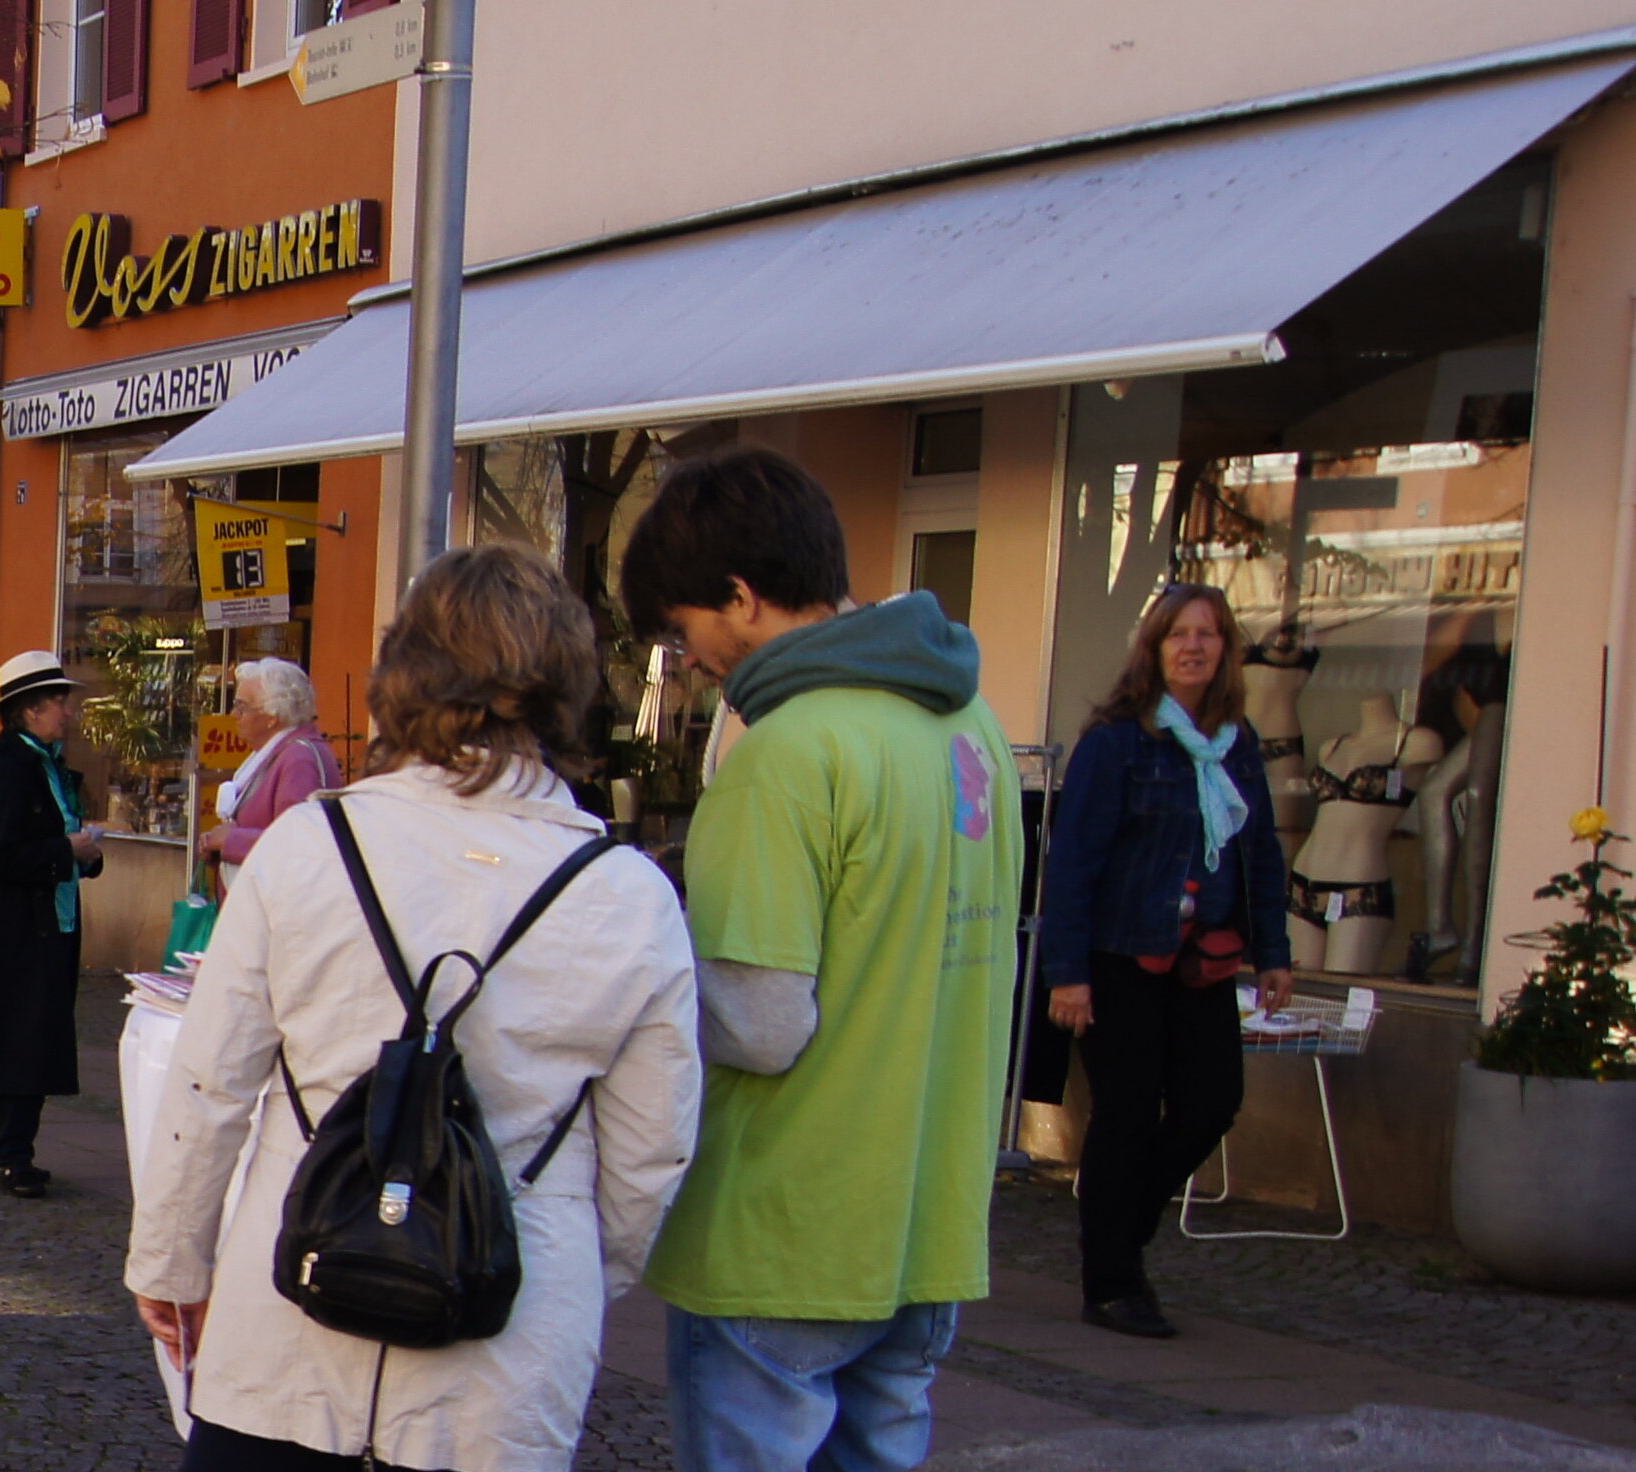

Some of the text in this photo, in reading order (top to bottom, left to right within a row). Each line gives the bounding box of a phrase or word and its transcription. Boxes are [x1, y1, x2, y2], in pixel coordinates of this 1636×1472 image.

[62, 200, 359, 329] Voss ZIGARREN
[8, 389, 95, 437] Lotto-Toto
[114, 360, 232, 419] ZIGARREN
[213, 517, 270, 540] JACKPOT
